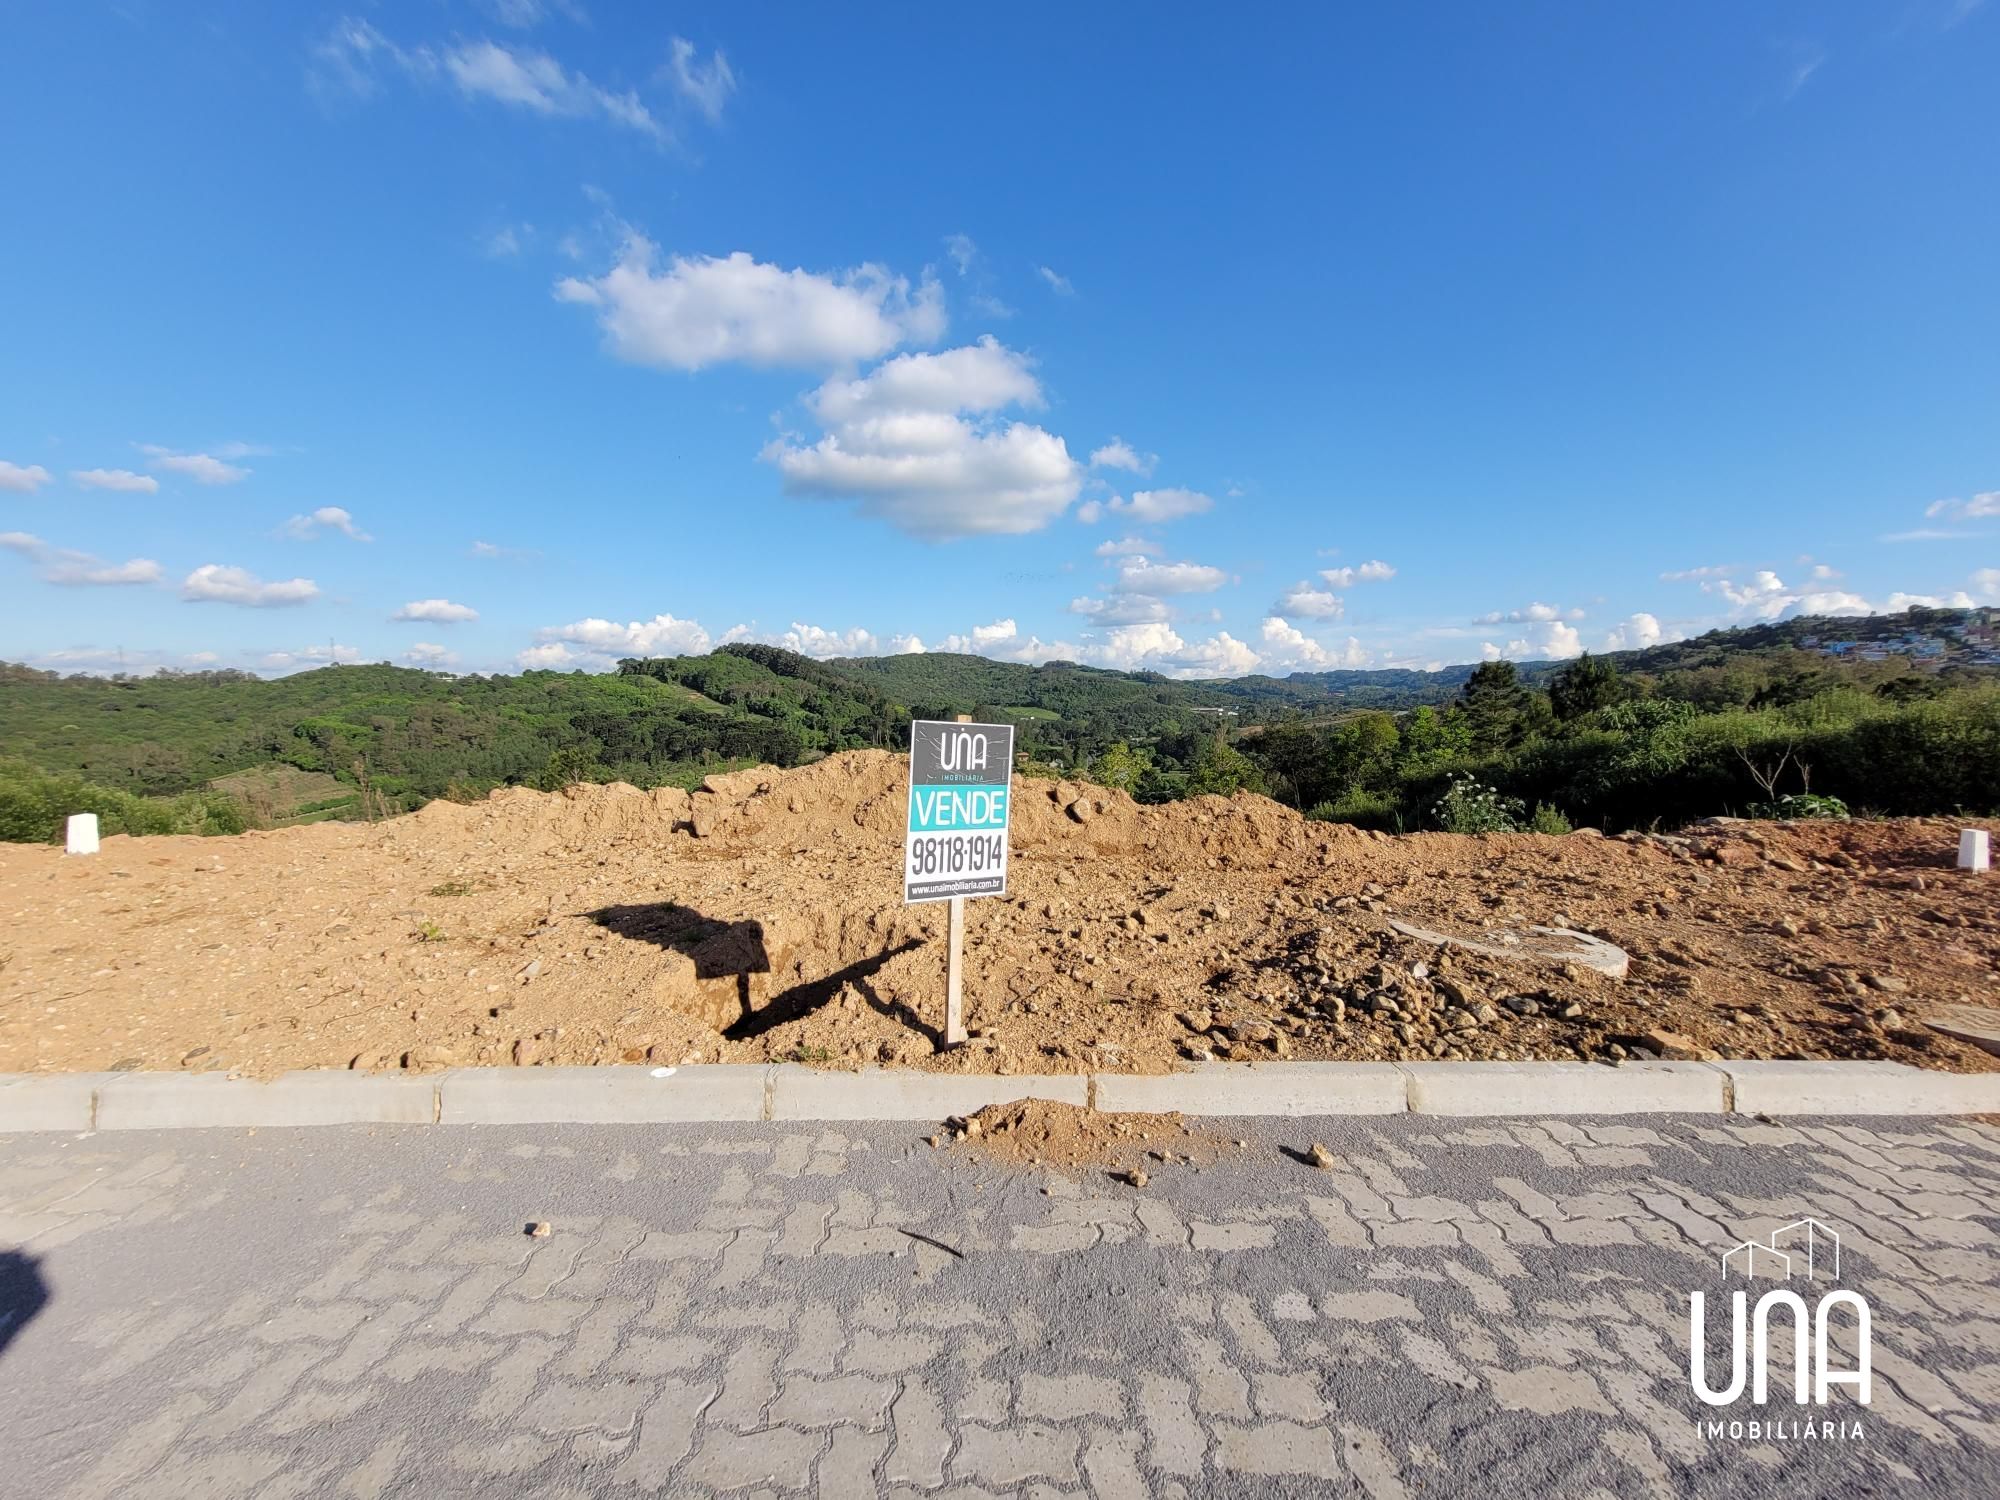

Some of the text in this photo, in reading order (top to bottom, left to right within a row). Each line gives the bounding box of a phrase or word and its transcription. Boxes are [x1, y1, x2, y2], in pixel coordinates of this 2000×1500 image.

[941, 732, 987, 771] UNA
[915, 790, 1005, 826] VENDE
[911, 879, 1000, 894] www.unaimobiliaria.com.br
